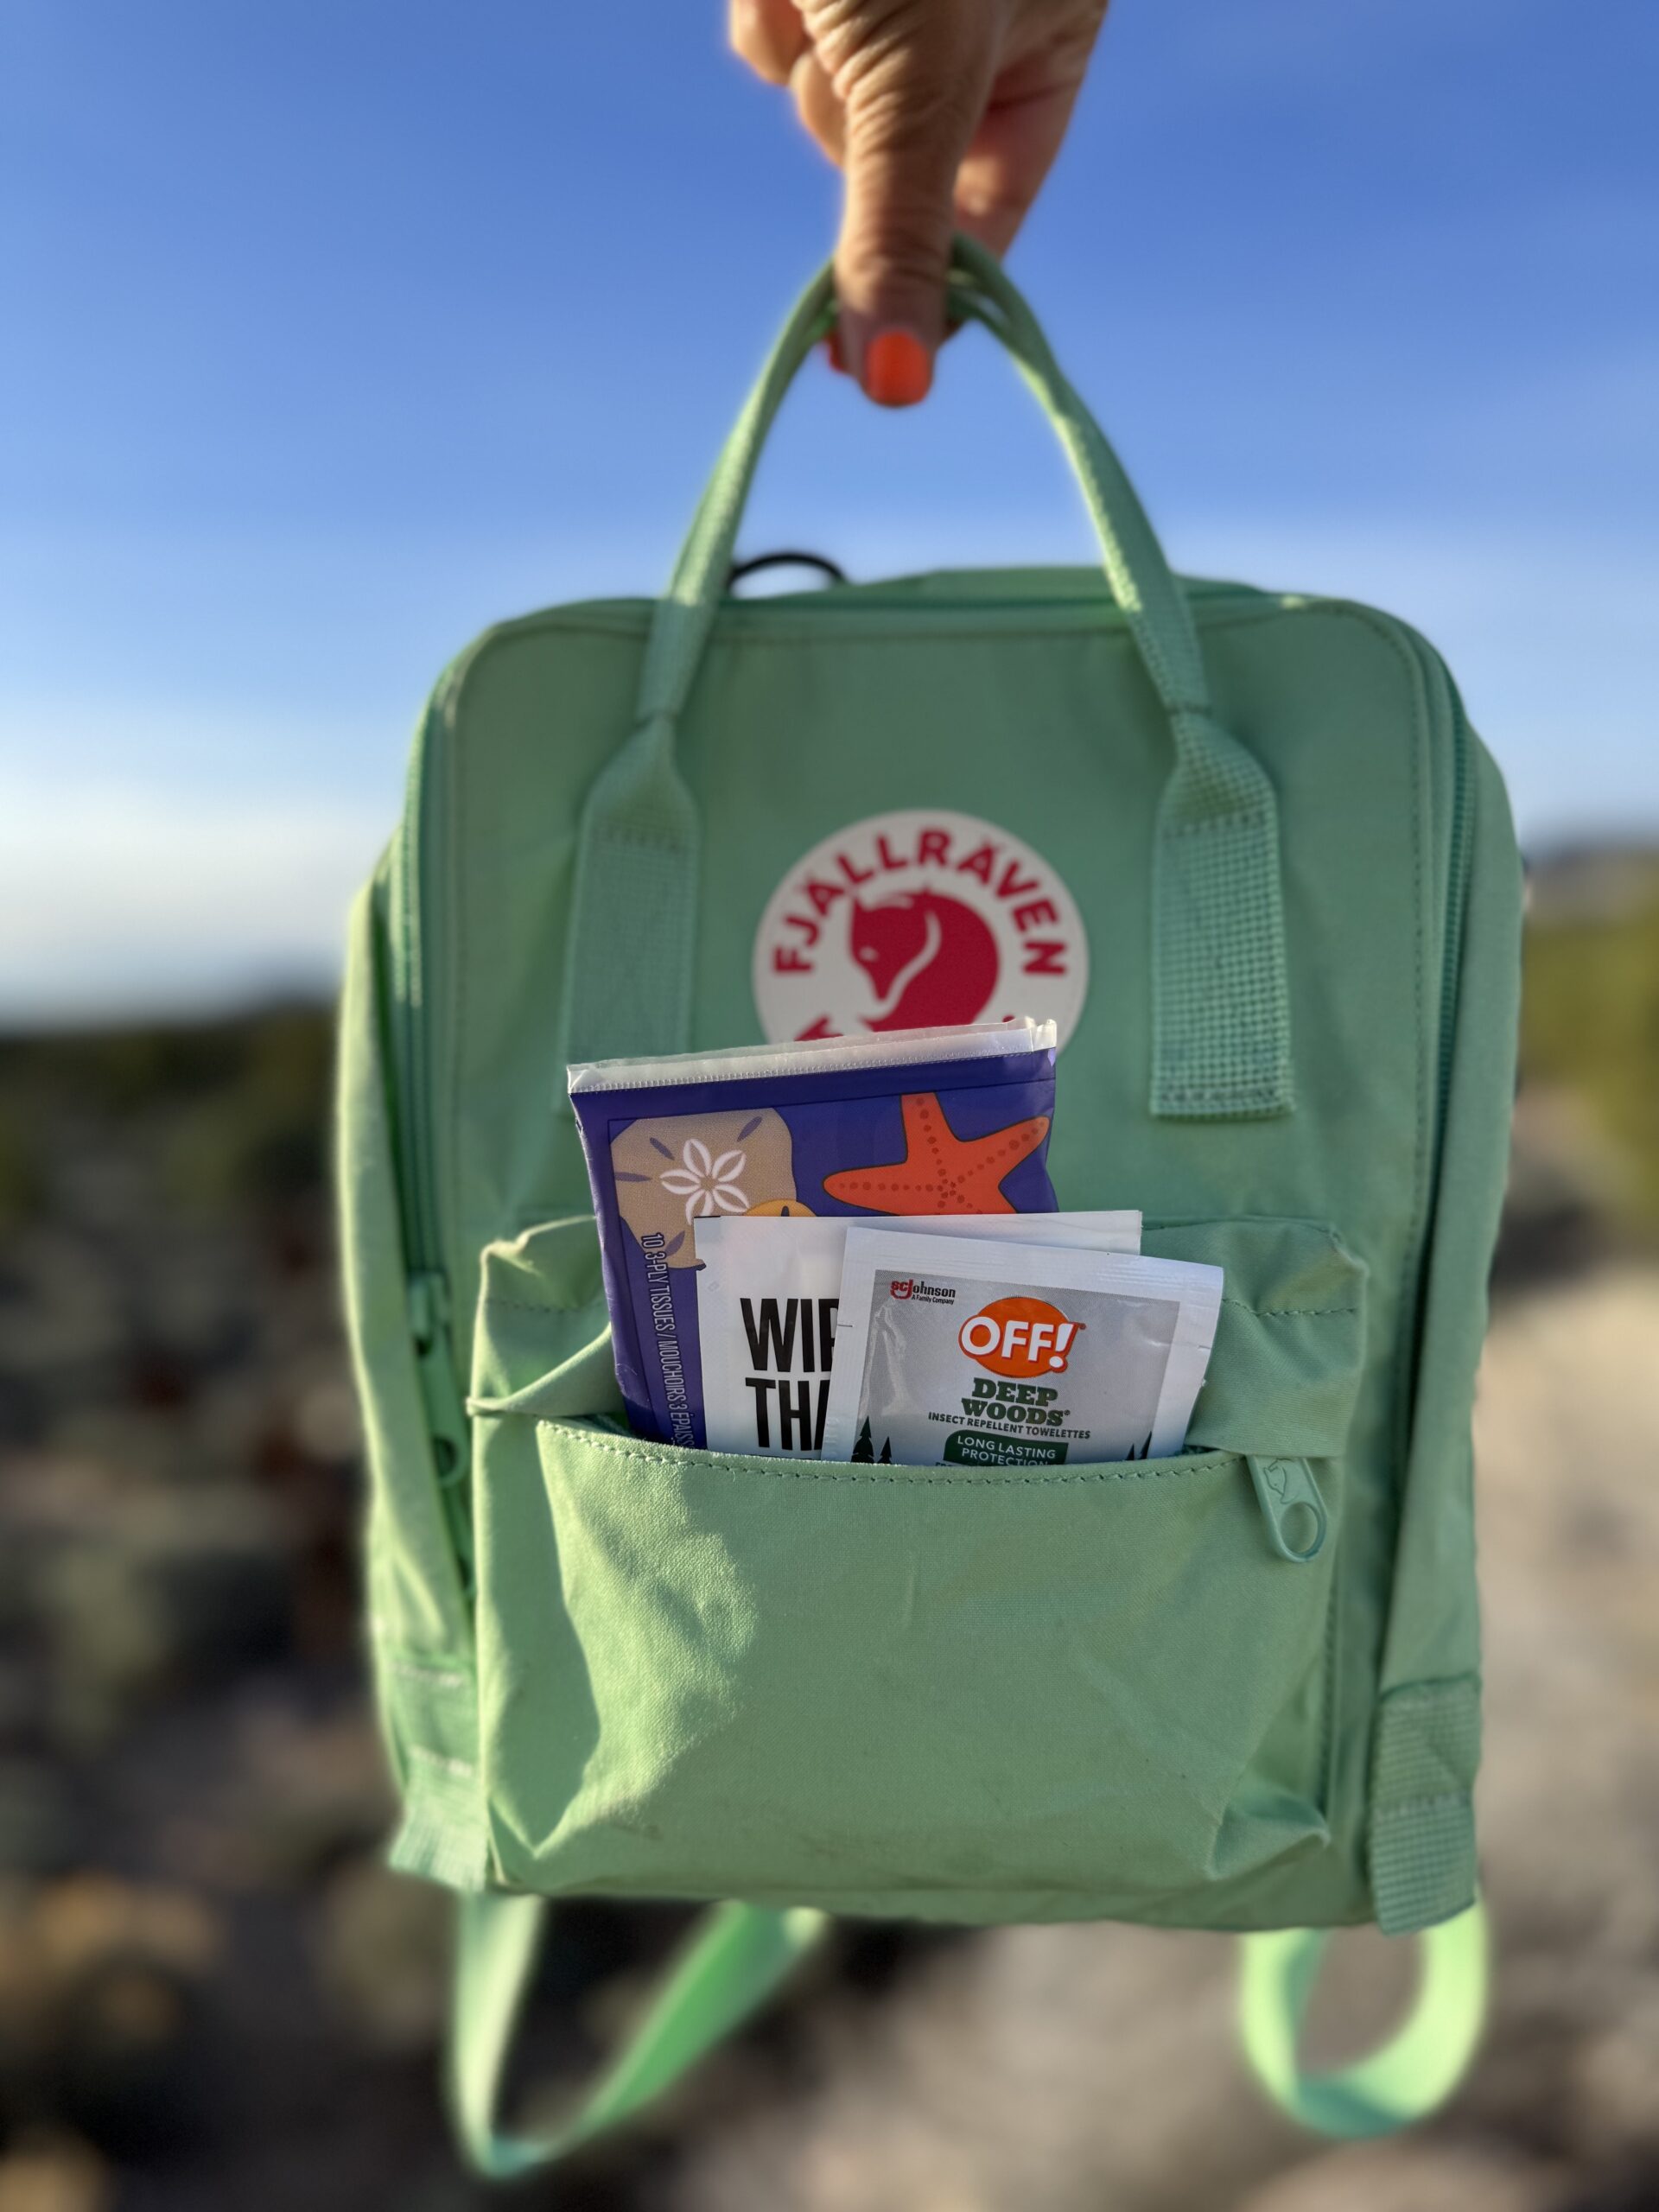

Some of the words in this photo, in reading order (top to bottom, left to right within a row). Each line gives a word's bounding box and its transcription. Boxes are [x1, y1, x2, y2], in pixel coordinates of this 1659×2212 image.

[773, 828, 1068, 976] FJÄLLRÄVEN
[642, 1233, 664, 1249] 10
[645, 1252, 669, 1283] 3-PLY
[649, 1285, 676, 1332] TISSUES
[916, 1295, 932, 1304] Family
[932, 1296, 955, 1306] Company
[658, 1340, 687, 1402] MOUCHOIRS
[971, 1376, 1058, 1407] DEEP
[670, 1411, 696, 1448] ÉPAISS
[928, 1411, 965, 1425] INSECT
[967, 1418, 1023, 1434] REPELLENT
[1026, 1426, 1090, 1440] TOWELETTES
[957, 1435, 995, 1450] LONG
[998, 1442, 1056, 1459] LASTING
